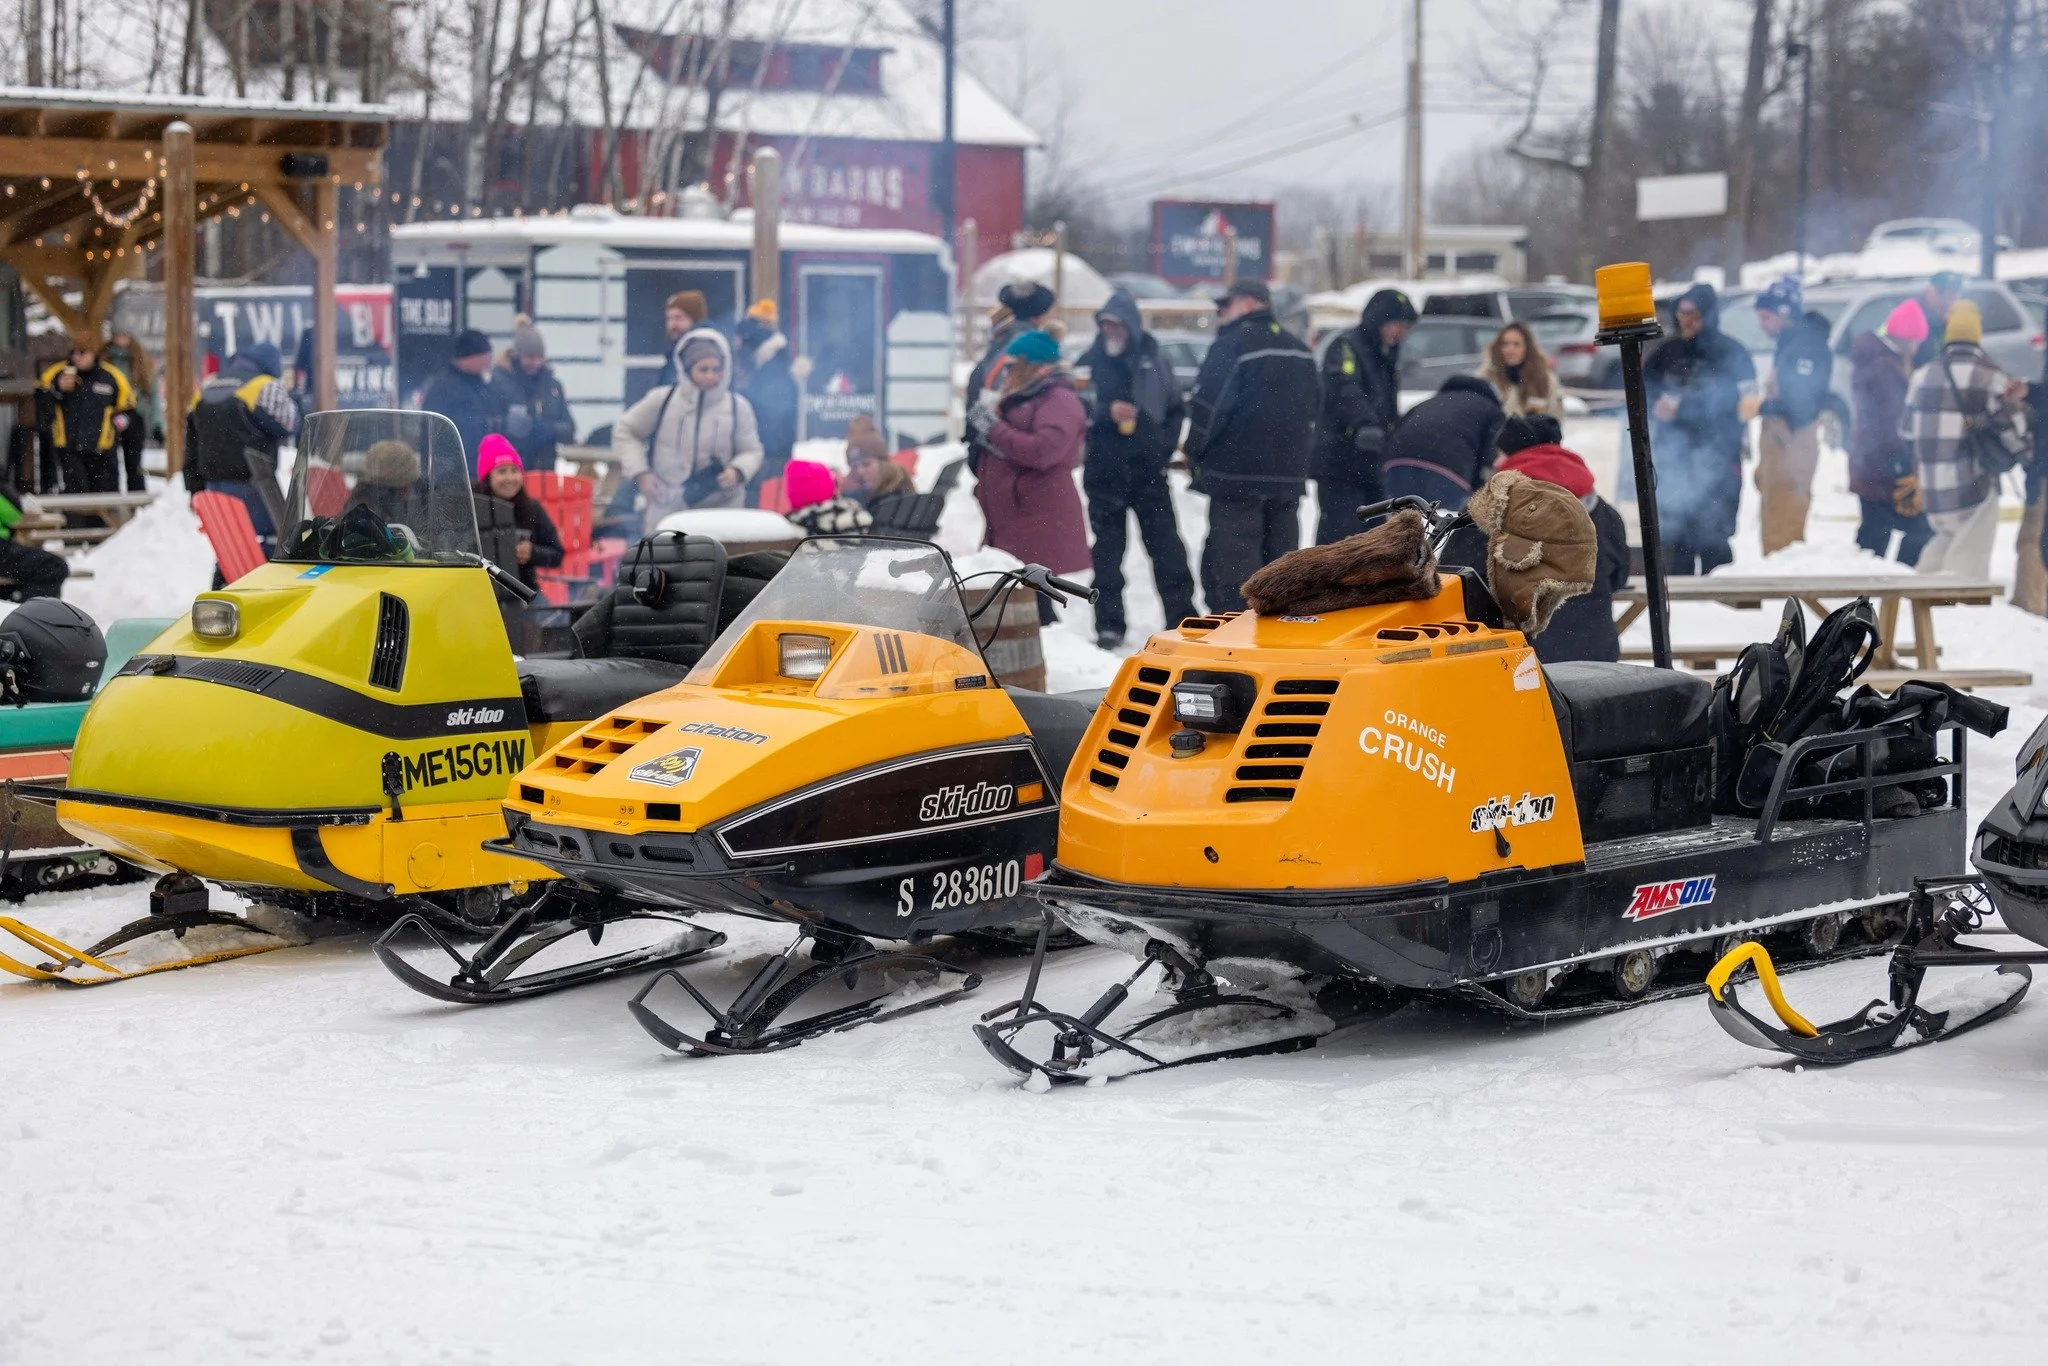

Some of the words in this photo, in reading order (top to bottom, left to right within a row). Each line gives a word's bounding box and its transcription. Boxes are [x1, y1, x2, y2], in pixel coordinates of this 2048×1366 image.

[446, 707, 504, 726] ski-doo
[680, 722, 769, 745] citation
[1384, 710, 1447, 748] ORANGE
[404, 739, 525, 790] ME15G1W
[1359, 727, 1456, 793] CRUSH
[920, 782, 1013, 821] ski-doo
[897, 877, 914, 917] S
[931, 860, 1019, 910] 283610
[1623, 875, 1716, 922] AMSOIL
